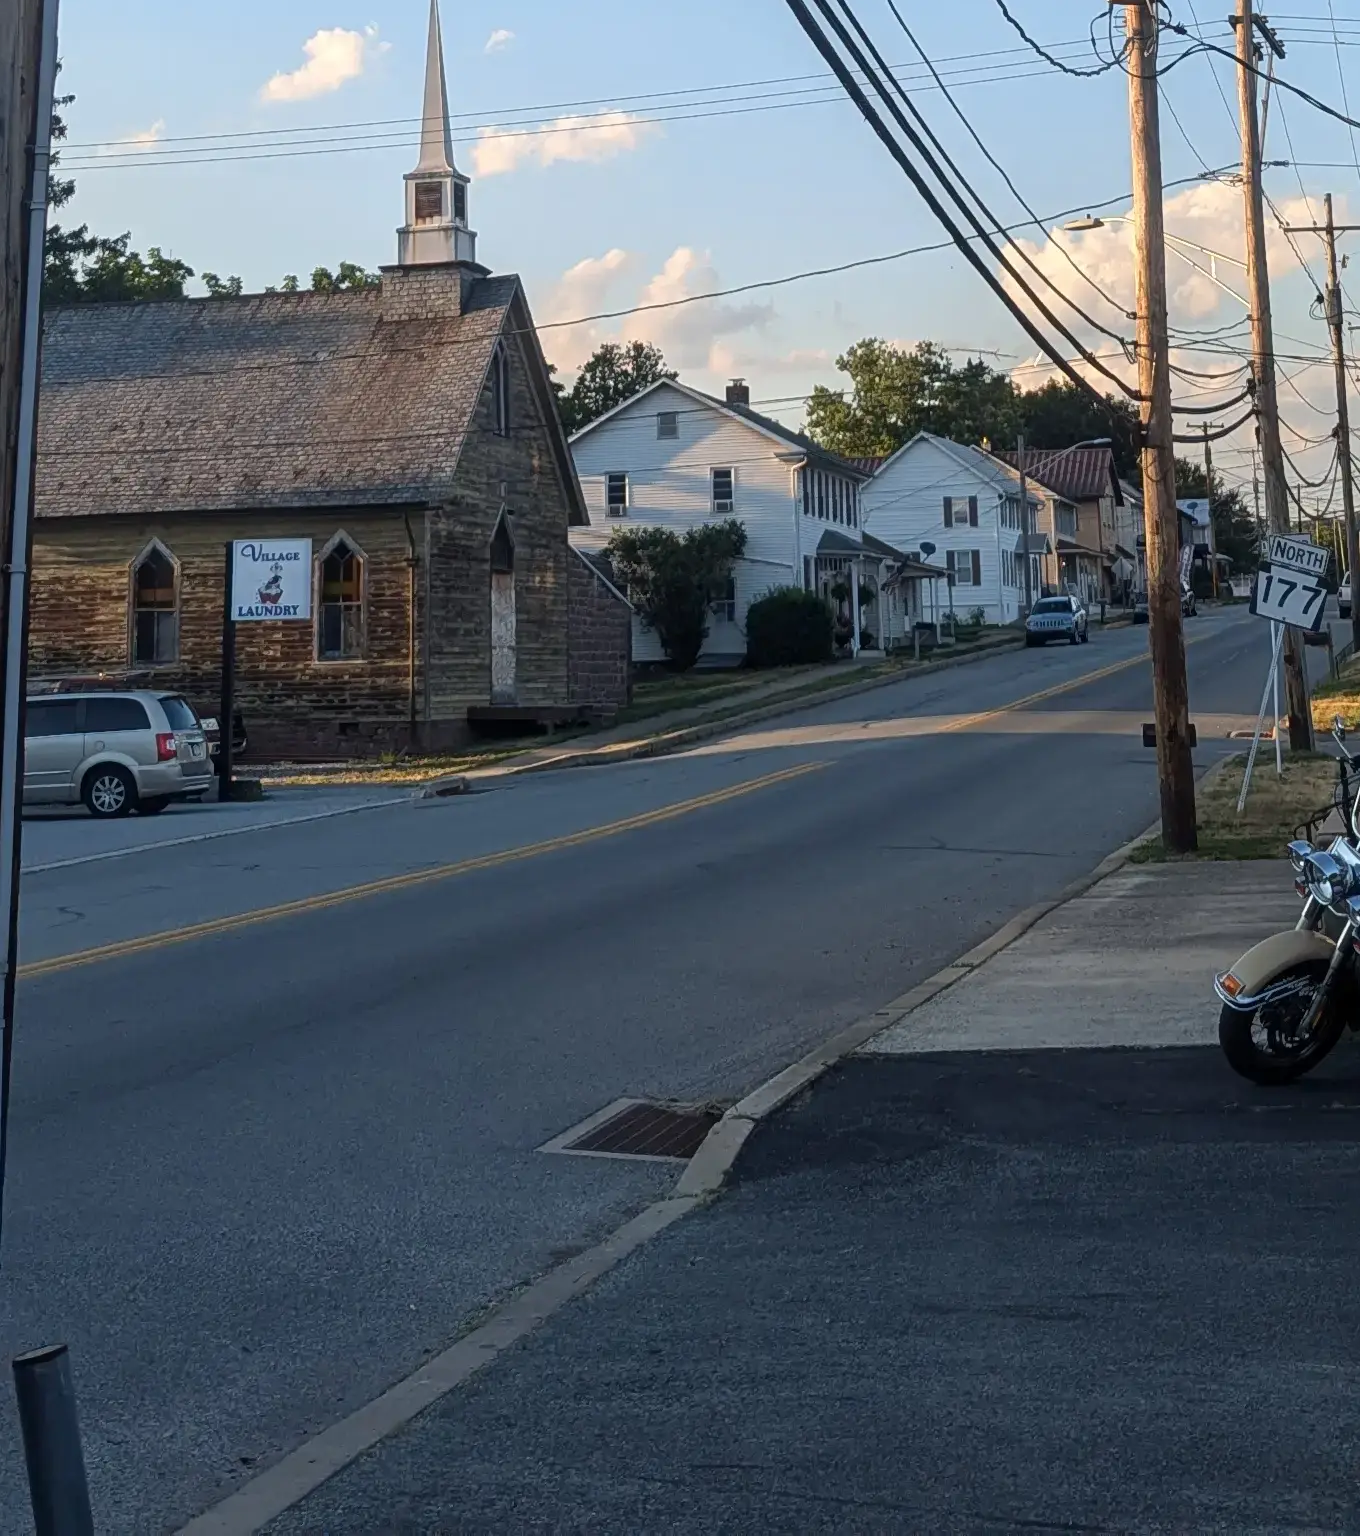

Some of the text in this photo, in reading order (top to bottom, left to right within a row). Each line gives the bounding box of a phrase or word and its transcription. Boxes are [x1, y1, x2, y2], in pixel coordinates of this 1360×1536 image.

[241, 544, 301, 562] VILLAGE
[1274, 541, 1324, 569] NORTH
[1262, 575, 1322, 615] 177
[238, 605, 300, 617] LAUNDRY
